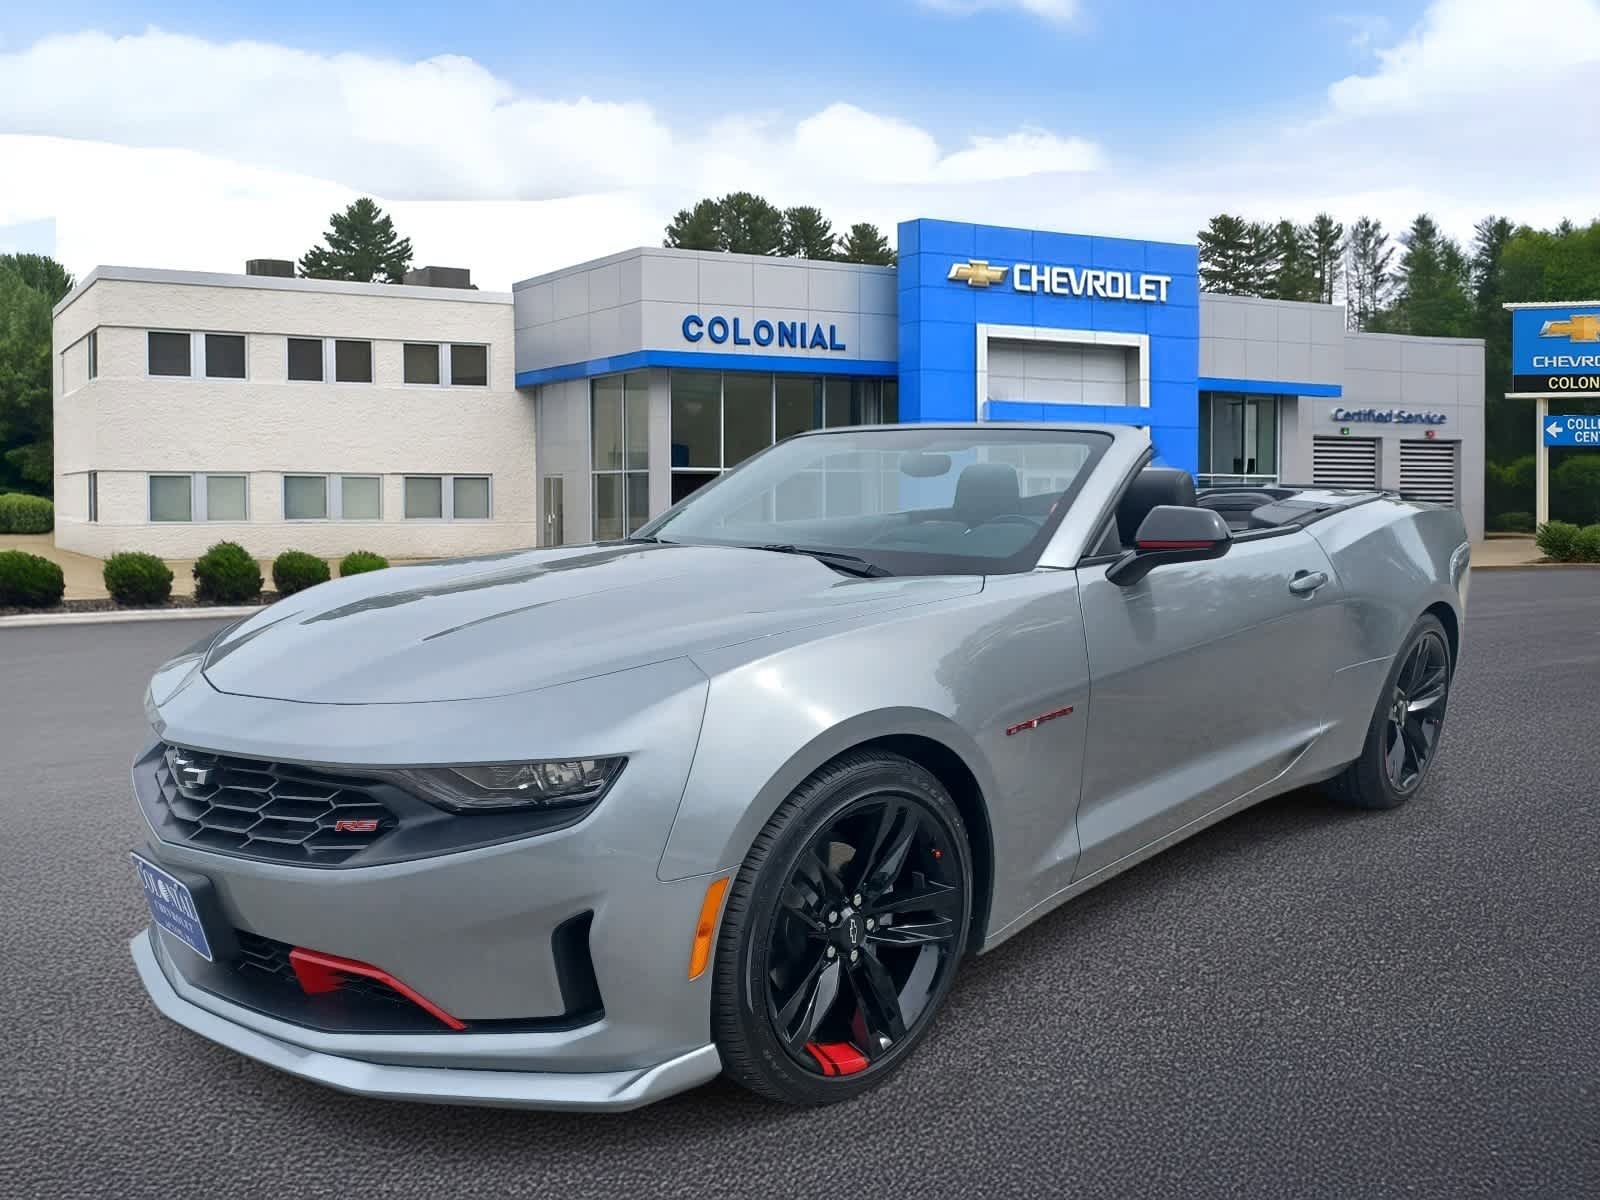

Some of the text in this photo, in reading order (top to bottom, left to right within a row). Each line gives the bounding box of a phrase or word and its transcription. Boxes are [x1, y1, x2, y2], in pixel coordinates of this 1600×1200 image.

[1013, 263, 1171, 303] CHEVROLET
[682, 314, 846, 351] COLONIAL
[1333, 408, 1447, 425] Certified Service
[1574, 431, 1600, 443] CEN
[335, 820, 378, 832] RS
